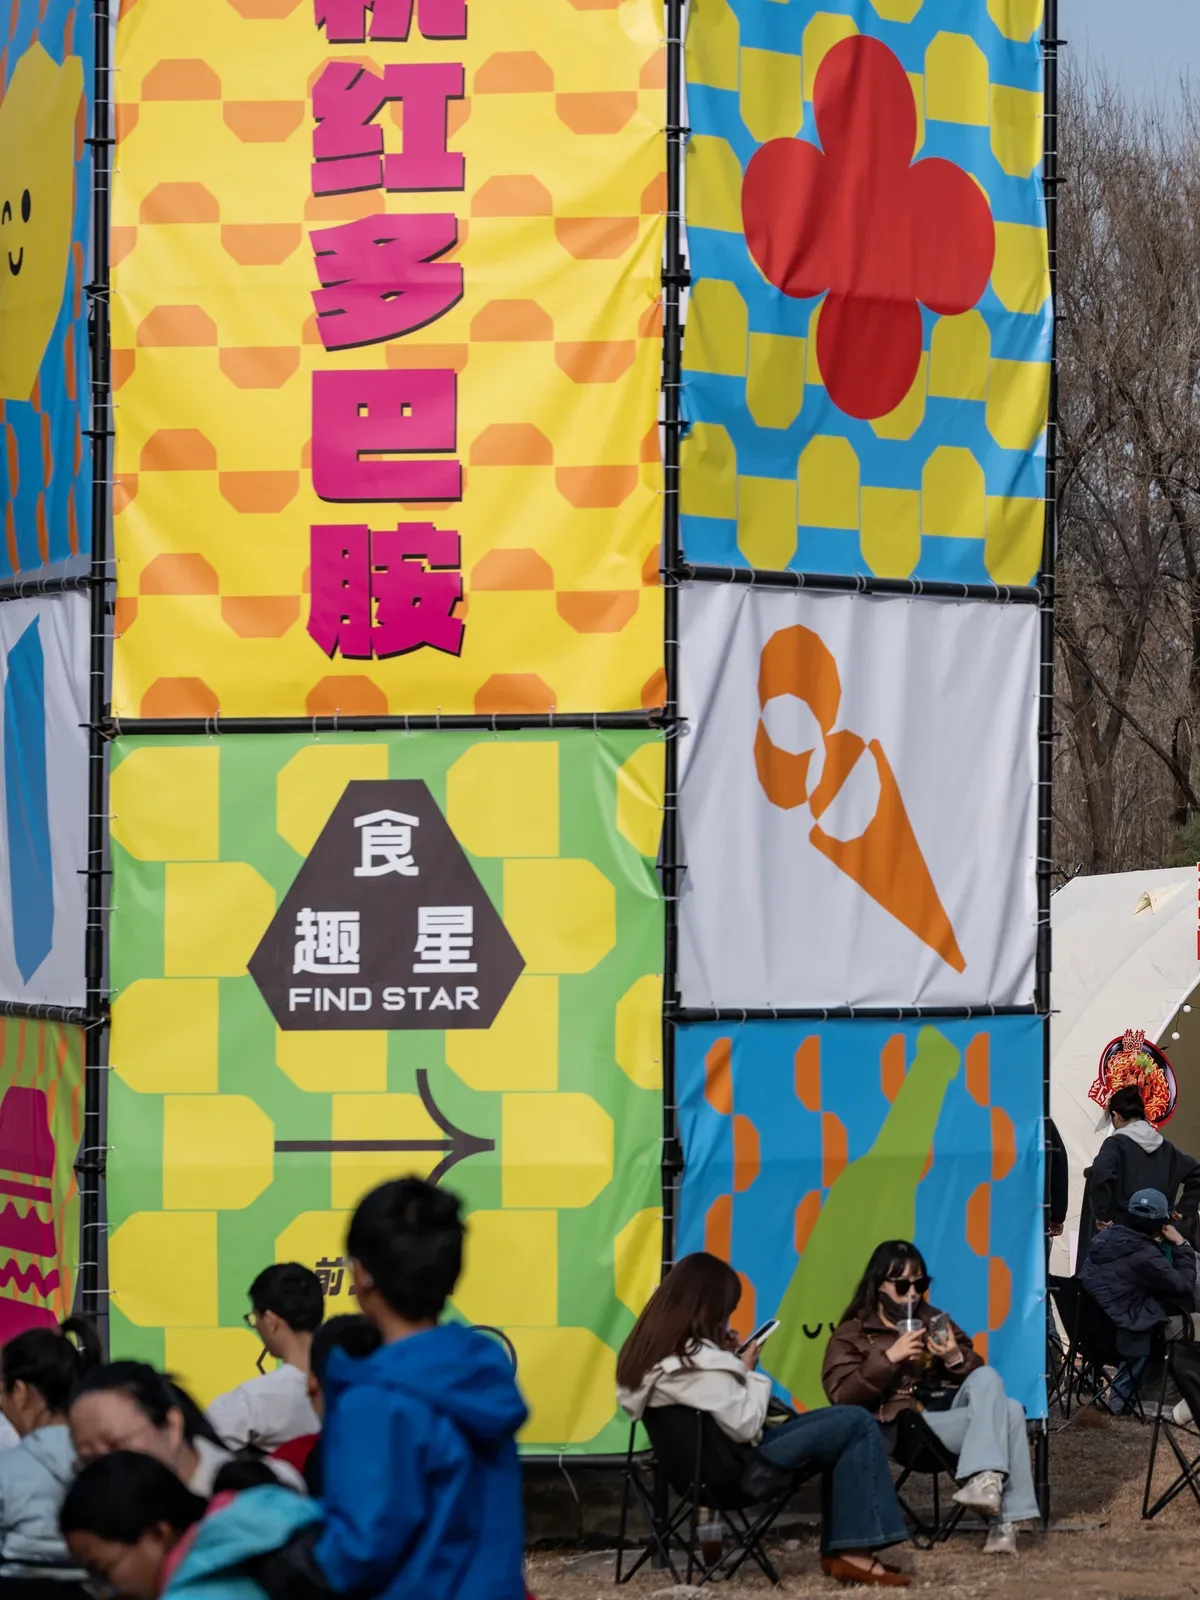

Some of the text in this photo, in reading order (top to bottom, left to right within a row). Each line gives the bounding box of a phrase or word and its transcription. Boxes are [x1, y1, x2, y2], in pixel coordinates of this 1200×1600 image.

[353, 809, 420, 877] 食
[292, 905, 478, 975] 趣 星
[288, 986, 481, 1012] FIND STAR
